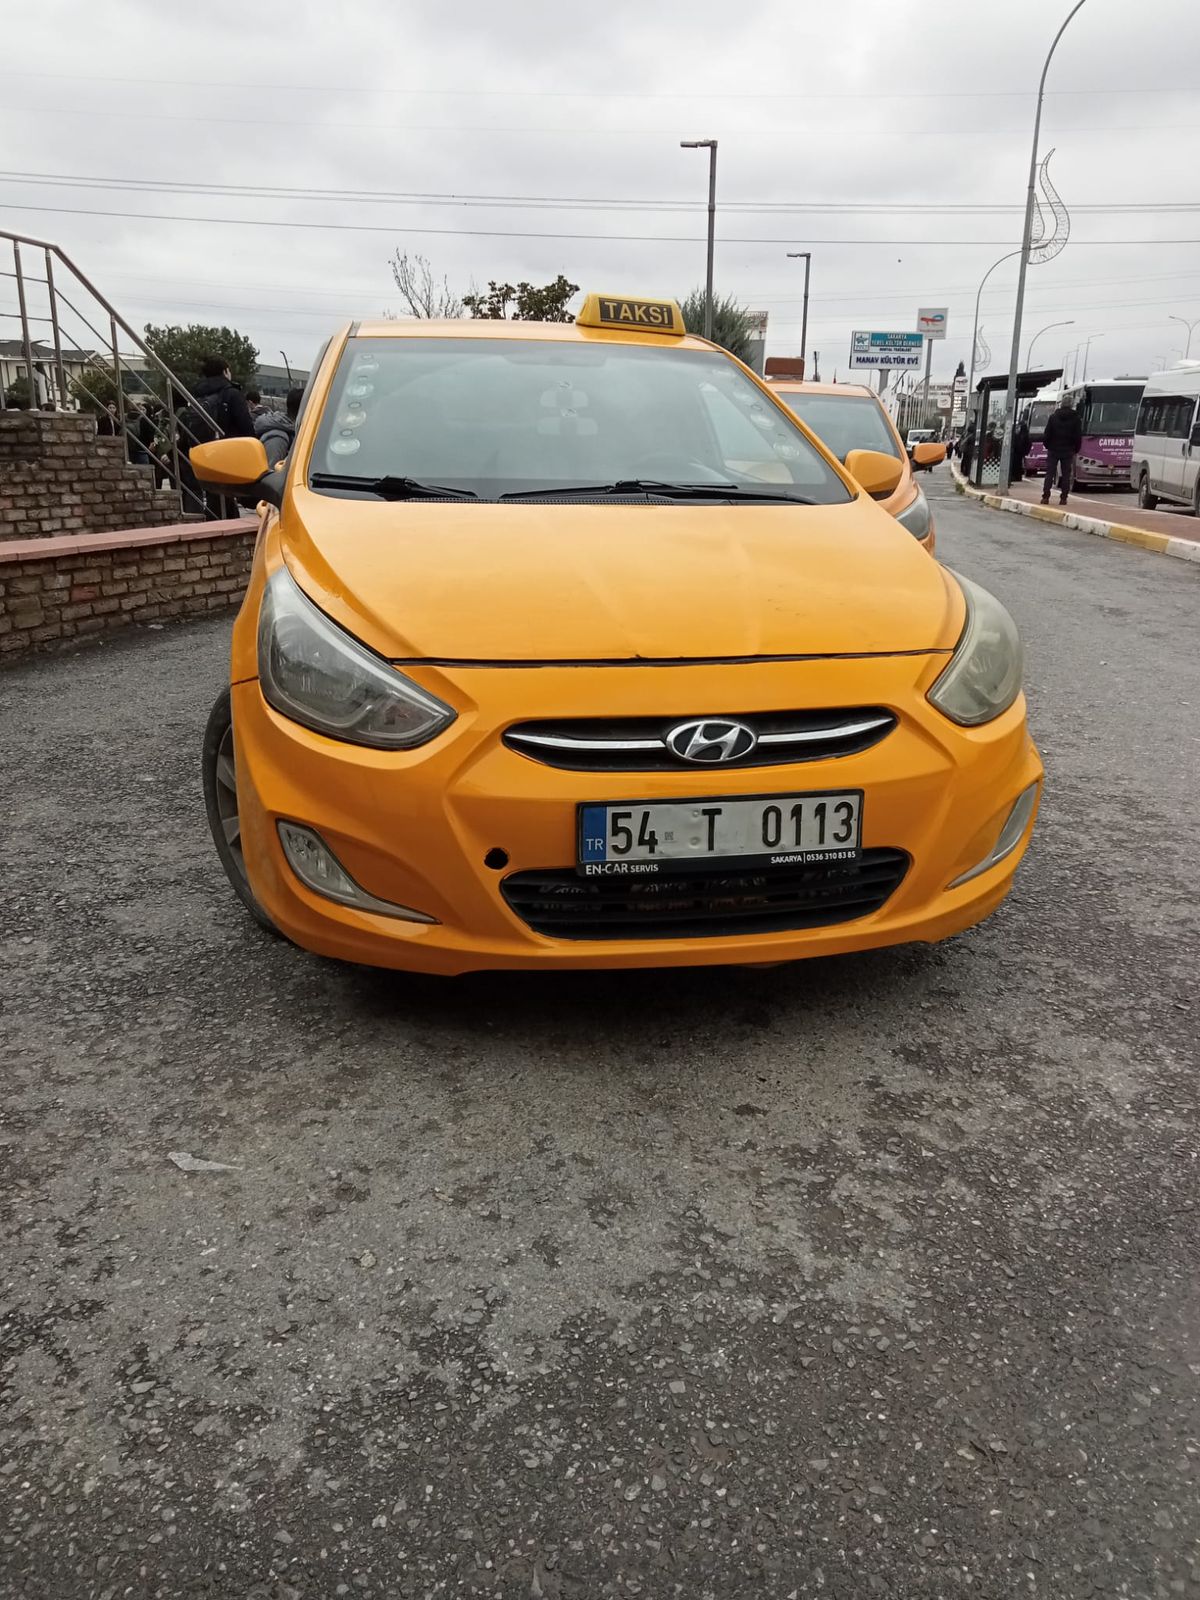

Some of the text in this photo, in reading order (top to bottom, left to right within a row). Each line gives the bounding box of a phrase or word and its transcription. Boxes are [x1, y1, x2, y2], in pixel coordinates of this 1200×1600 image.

[856, 355, 919, 365] MANAV KÜLTÜR EVİ
[611, 801, 854, 855] 54 T 0113
[586, 838, 604, 851] TR
[771, 855, 802, 864] SAKARYA
[806, 853, 824, 861] 0536
[824, 852, 837, 860] 310
[838, 851, 847, 859] 83
[585, 863, 659, 875] EN-CAR SERVIS
